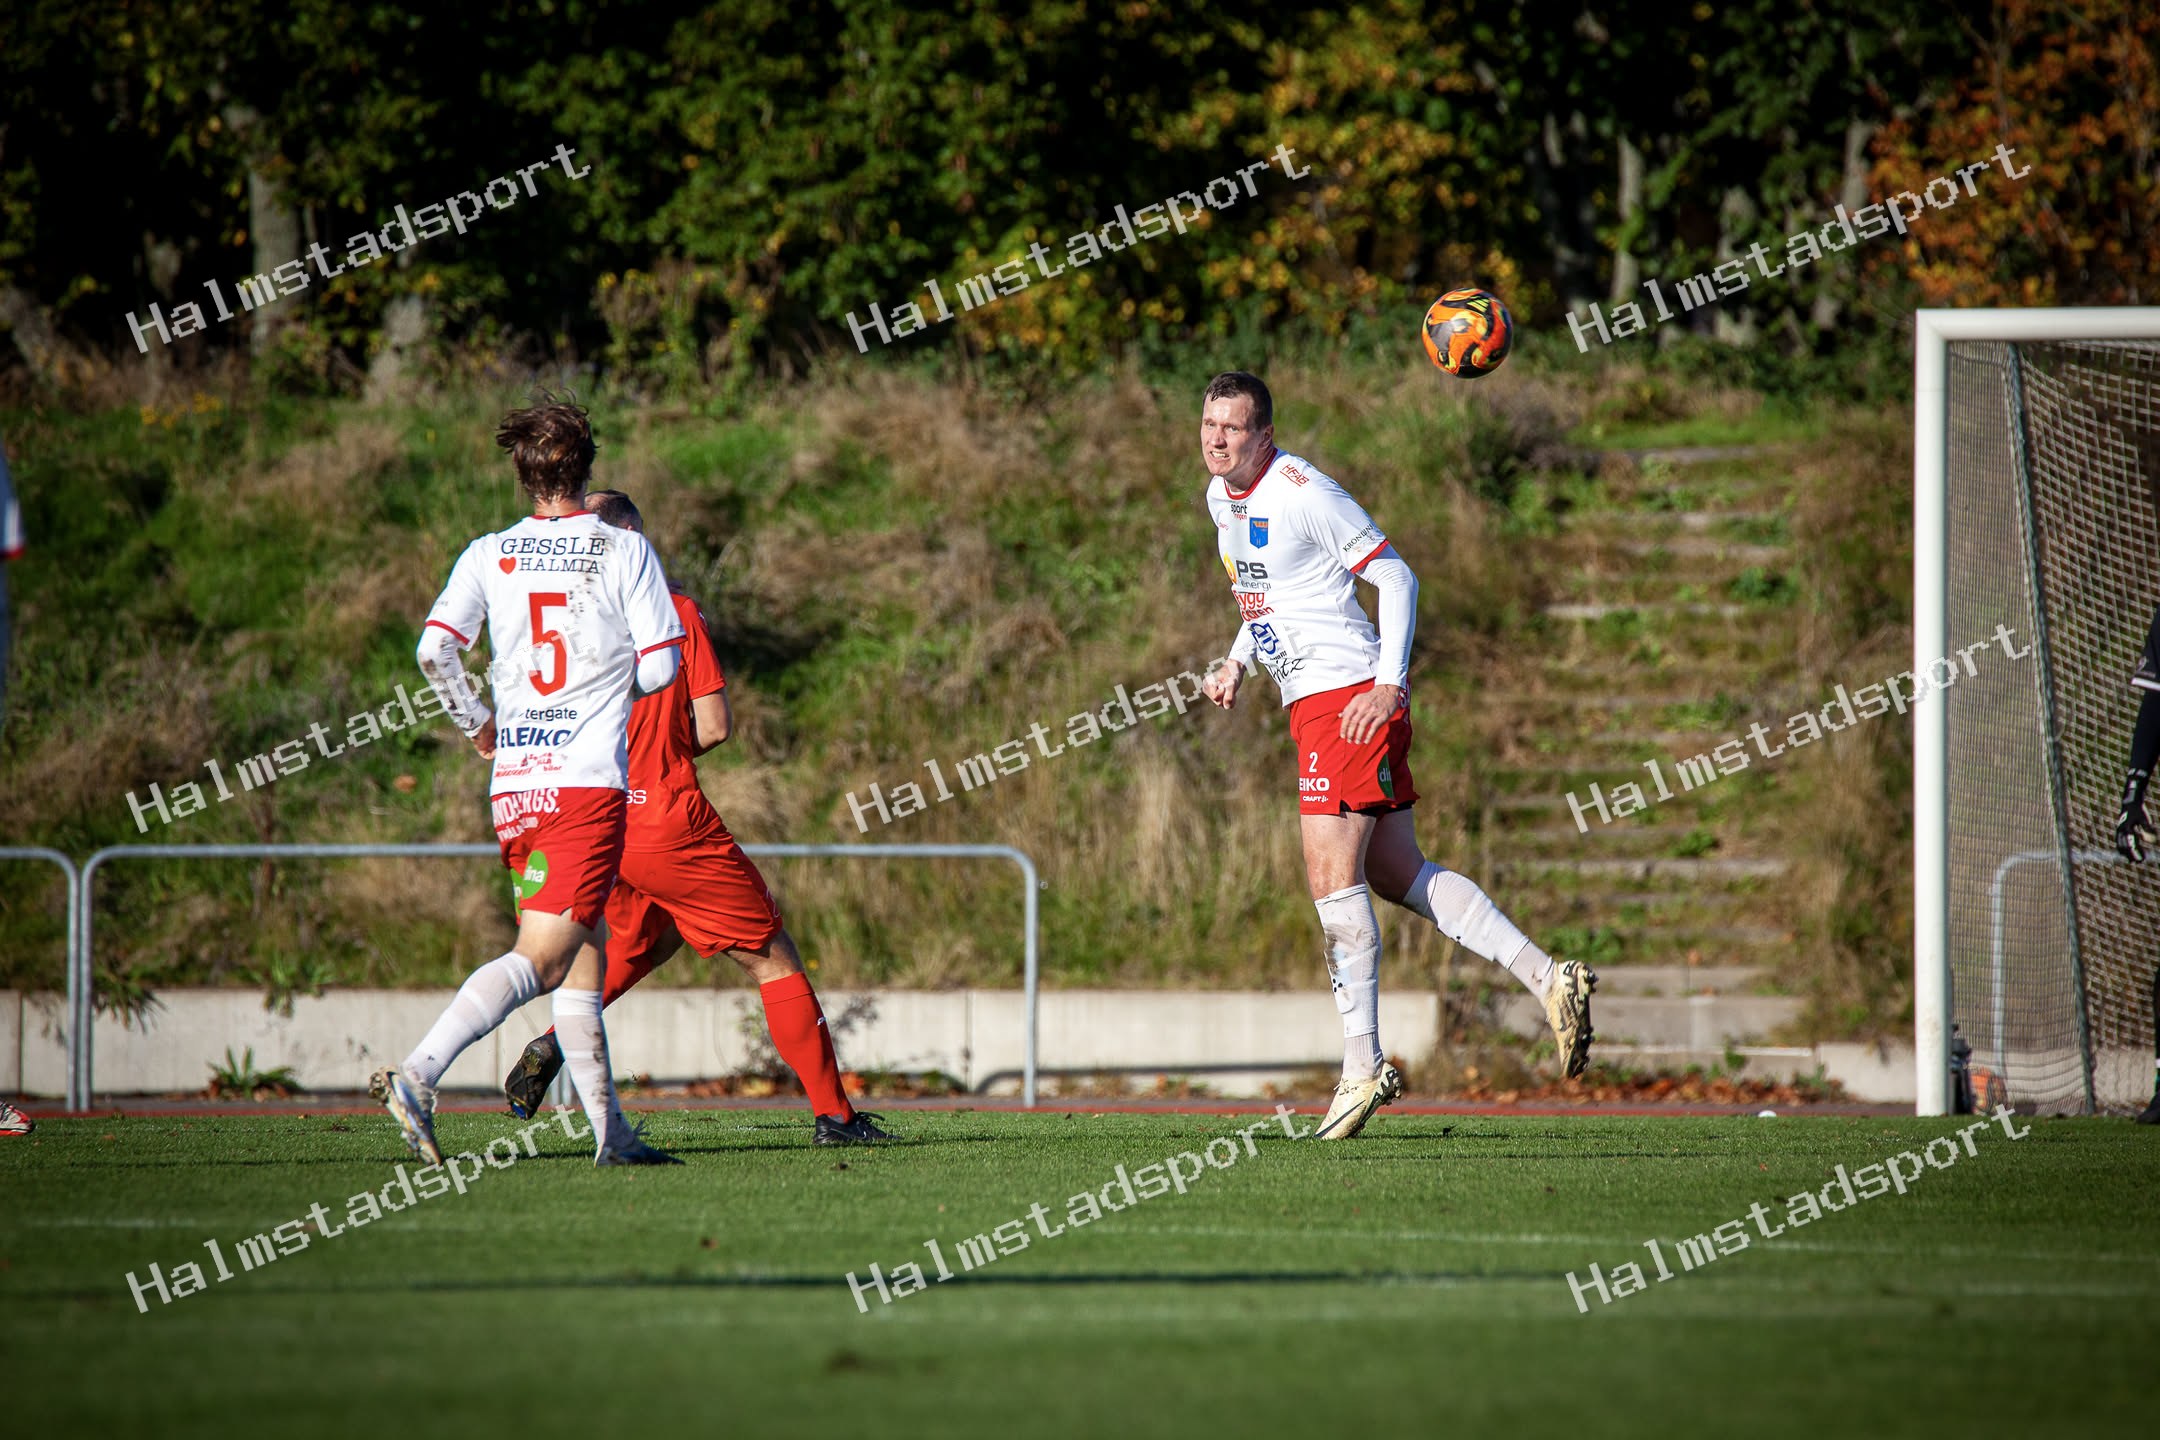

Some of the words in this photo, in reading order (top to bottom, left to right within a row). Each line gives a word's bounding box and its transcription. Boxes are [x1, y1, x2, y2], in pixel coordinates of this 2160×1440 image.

[501, 537, 606, 556] GESSLE
[518, 556, 601, 574] HALMIA
[1236, 560, 1269, 579] PS
[528, 593, 567, 697] 5
[1309, 752, 1318, 773] 2
